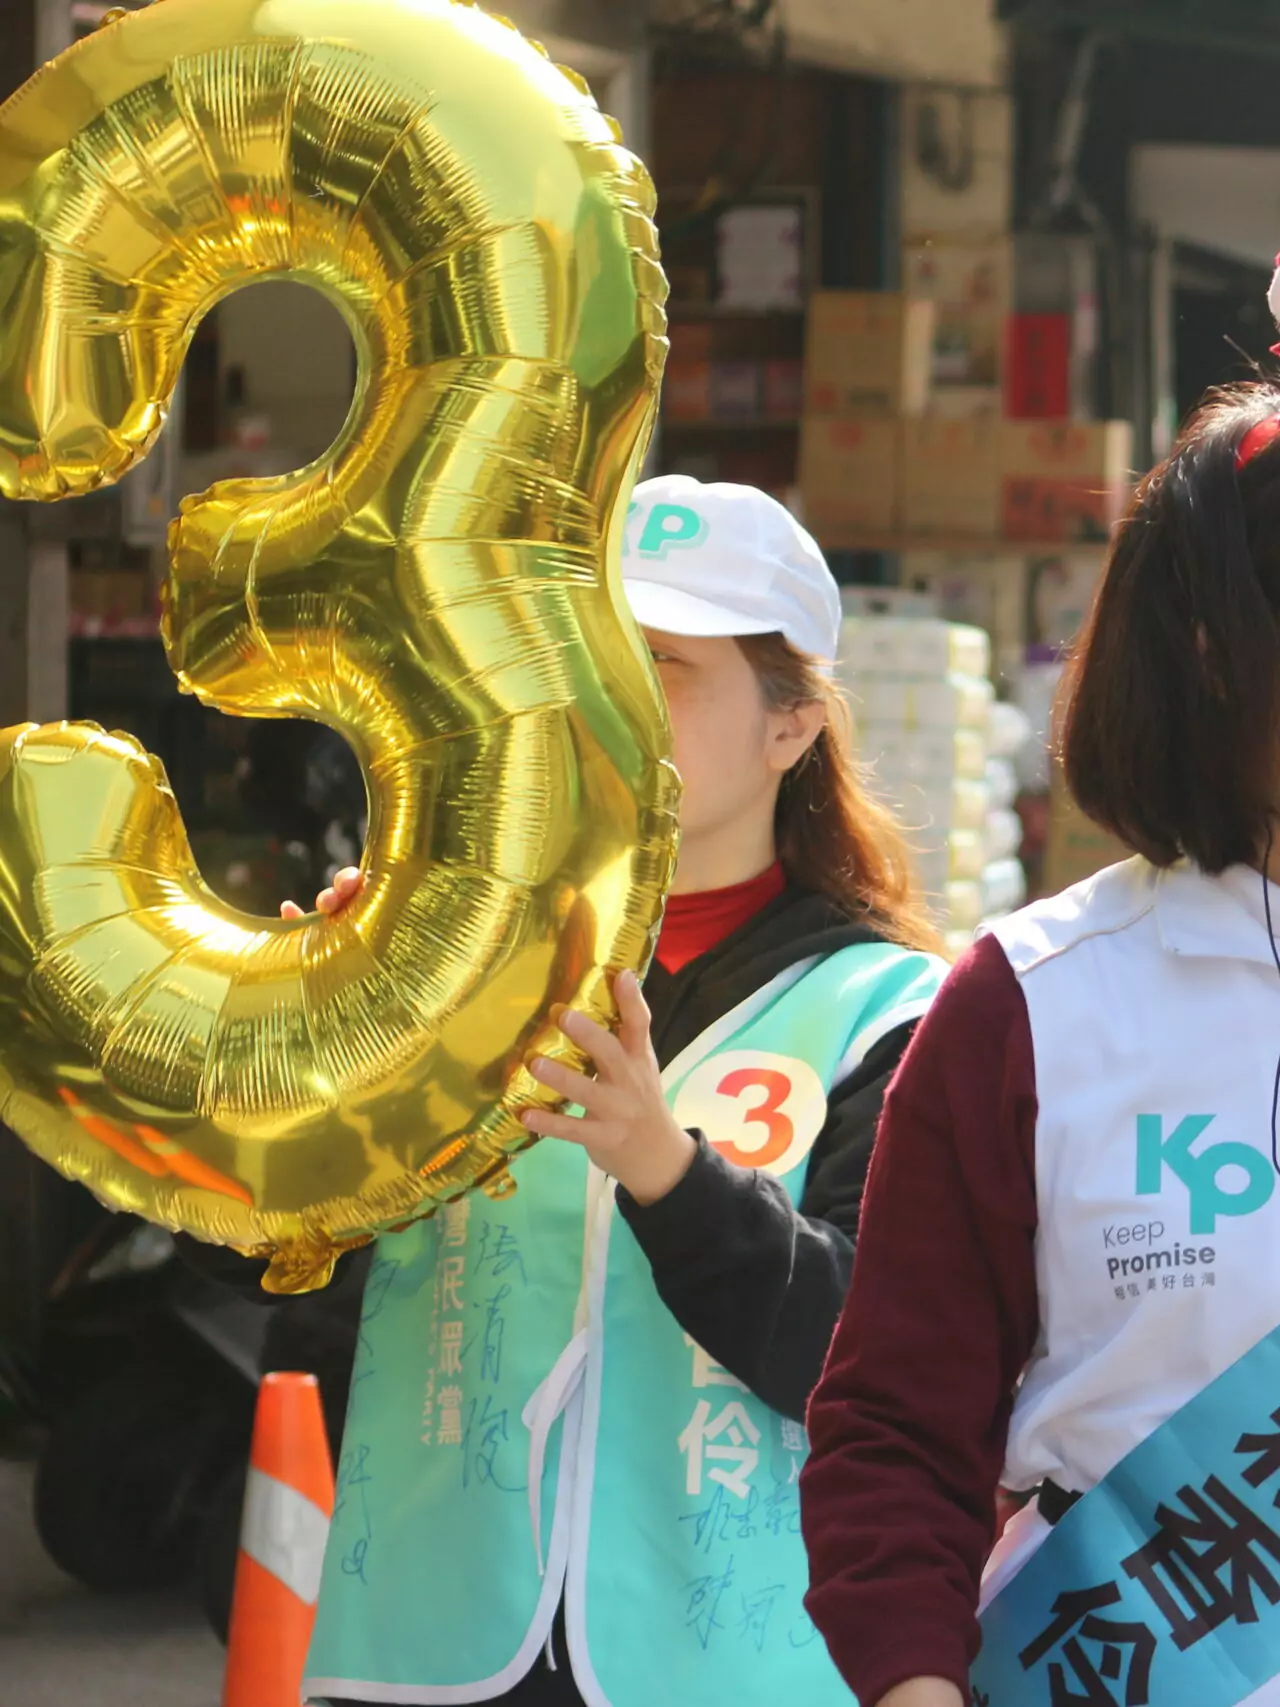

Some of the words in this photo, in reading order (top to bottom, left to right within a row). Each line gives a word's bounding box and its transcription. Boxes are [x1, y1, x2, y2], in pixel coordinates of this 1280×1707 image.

[622, 502, 702, 553] P
[711, 1067, 795, 1168] 3
[1103, 1220, 1165, 1249] Keep
[1107, 1242, 1216, 1280] Promise
